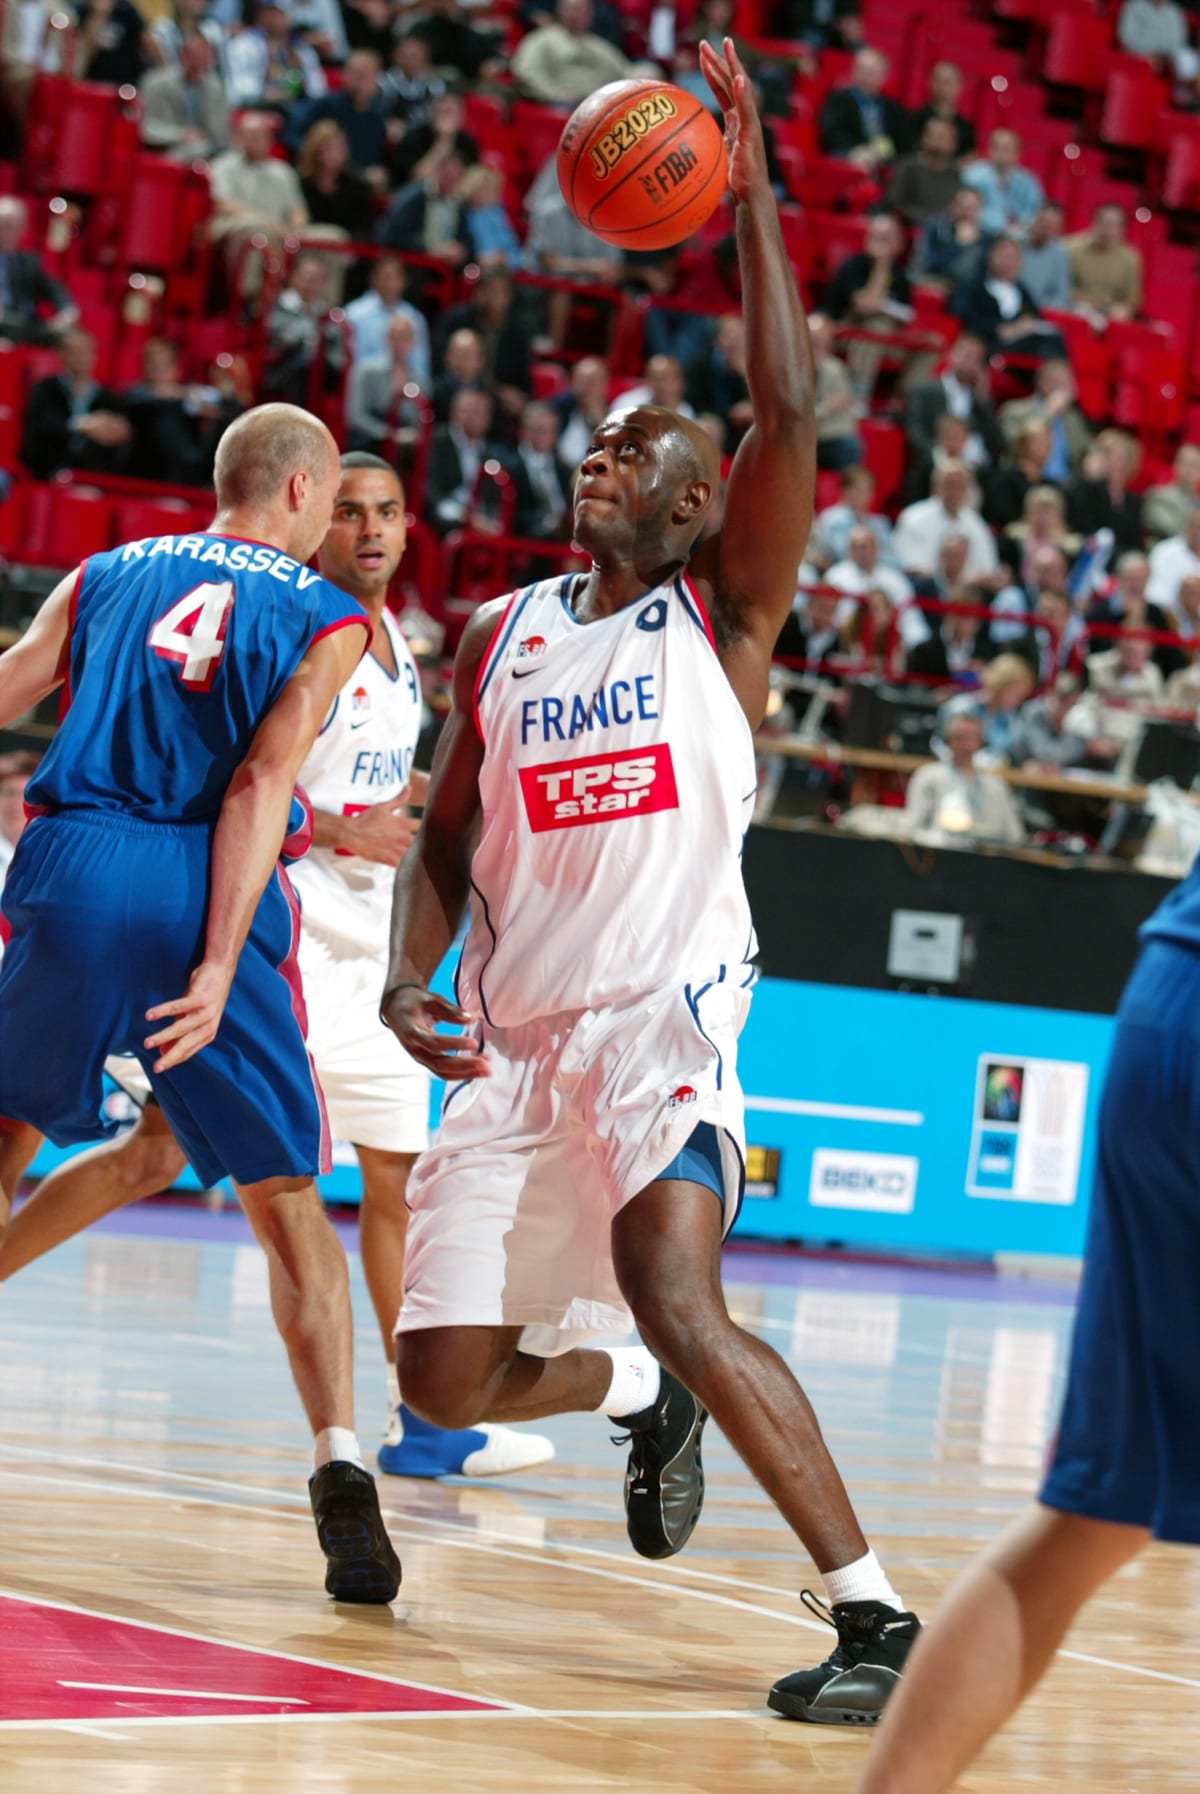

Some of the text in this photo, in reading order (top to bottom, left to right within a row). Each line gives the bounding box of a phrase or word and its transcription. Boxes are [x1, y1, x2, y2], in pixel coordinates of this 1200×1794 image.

[590, 92, 676, 179] JB2020
[654, 140, 698, 194] FIBA
[121, 535, 323, 590] KARASSEV
[147, 579, 236, 692] 4
[521, 674, 658, 745] FRANCE
[537, 756, 656, 801] TPS
[554, 788, 650, 820] star
